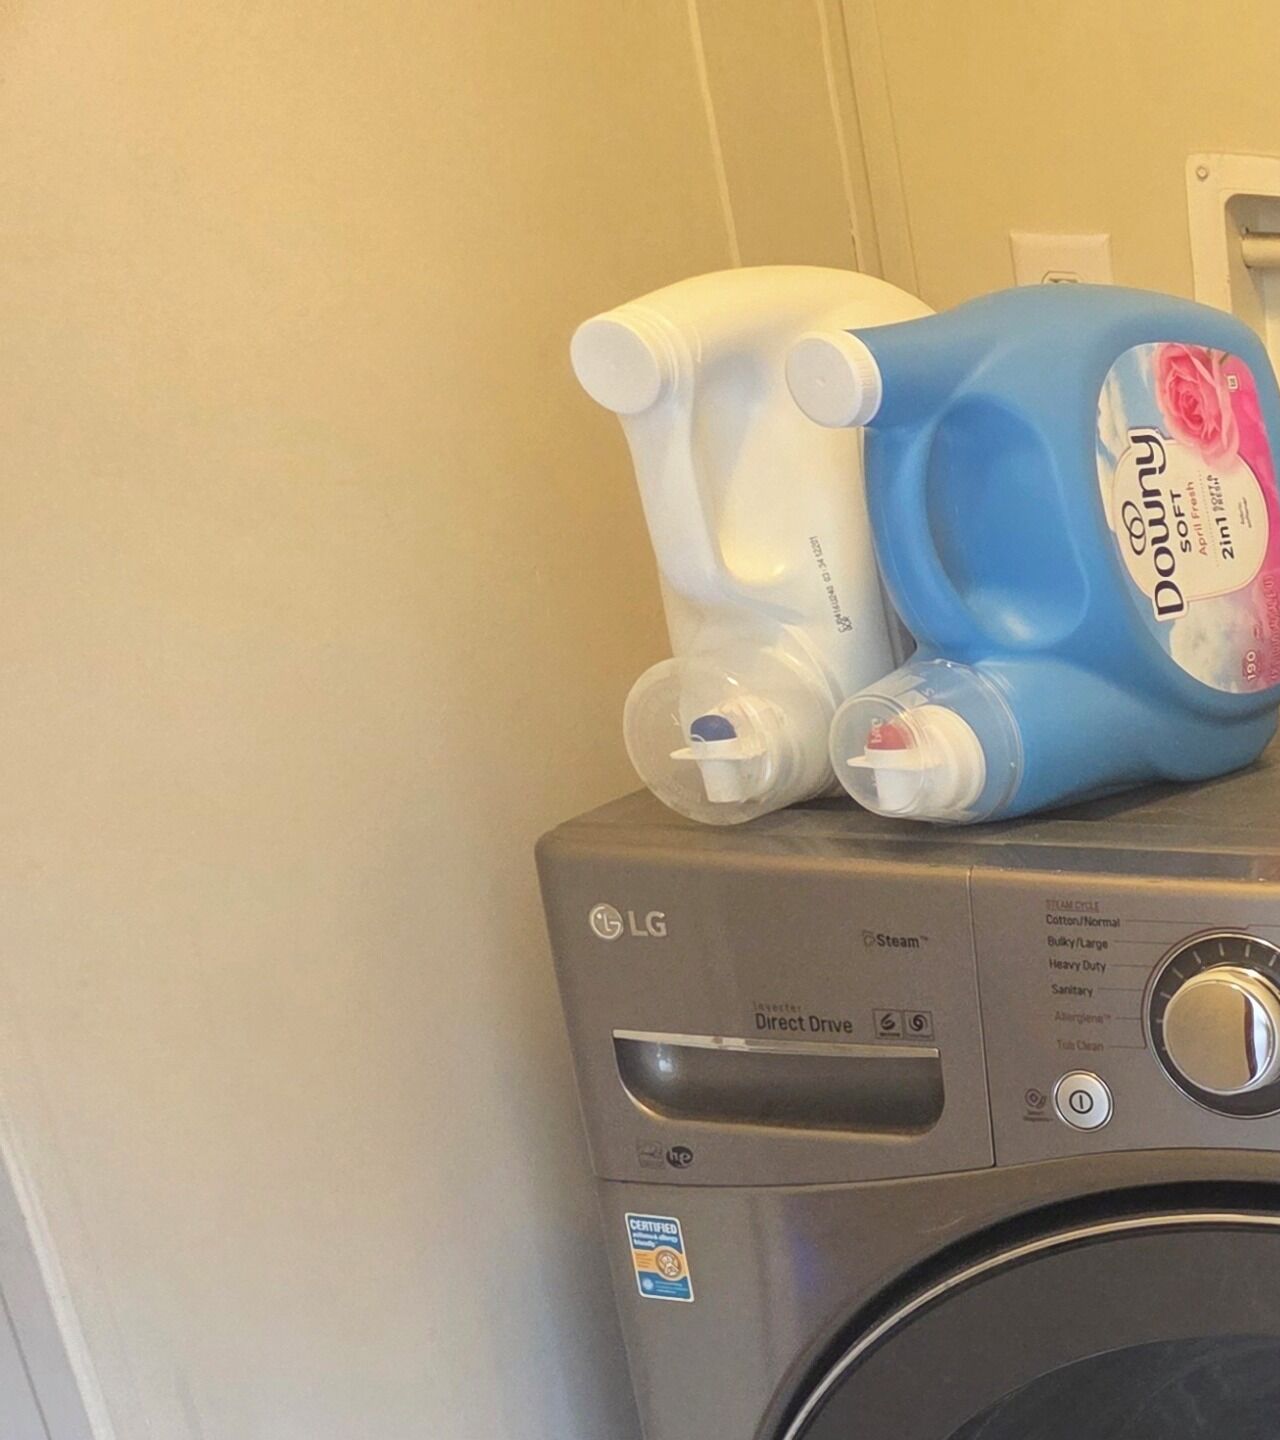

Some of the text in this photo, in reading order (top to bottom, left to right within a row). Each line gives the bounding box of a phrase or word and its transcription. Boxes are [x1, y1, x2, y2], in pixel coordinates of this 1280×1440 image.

[1130, 434, 1184, 616] Downy
[1170, 489, 1192, 553] SOFT
[1186, 481, 1208, 556] April Fresh
[1216, 517, 1234, 560] 2in1
[1247, 651, 1257, 680] 190
[628, 910, 667, 937] LG
[1046, 914, 1120, 928] Cotton/Normal
[1047, 936, 1108, 951] Bulky/Large
[1049, 958, 1106, 974] Heavy Duty
[1051, 984, 1094, 998] Sanitary
[755, 1013, 853, 1033] Direct Drive
[630, 1219, 677, 1234] CERTIFIED
